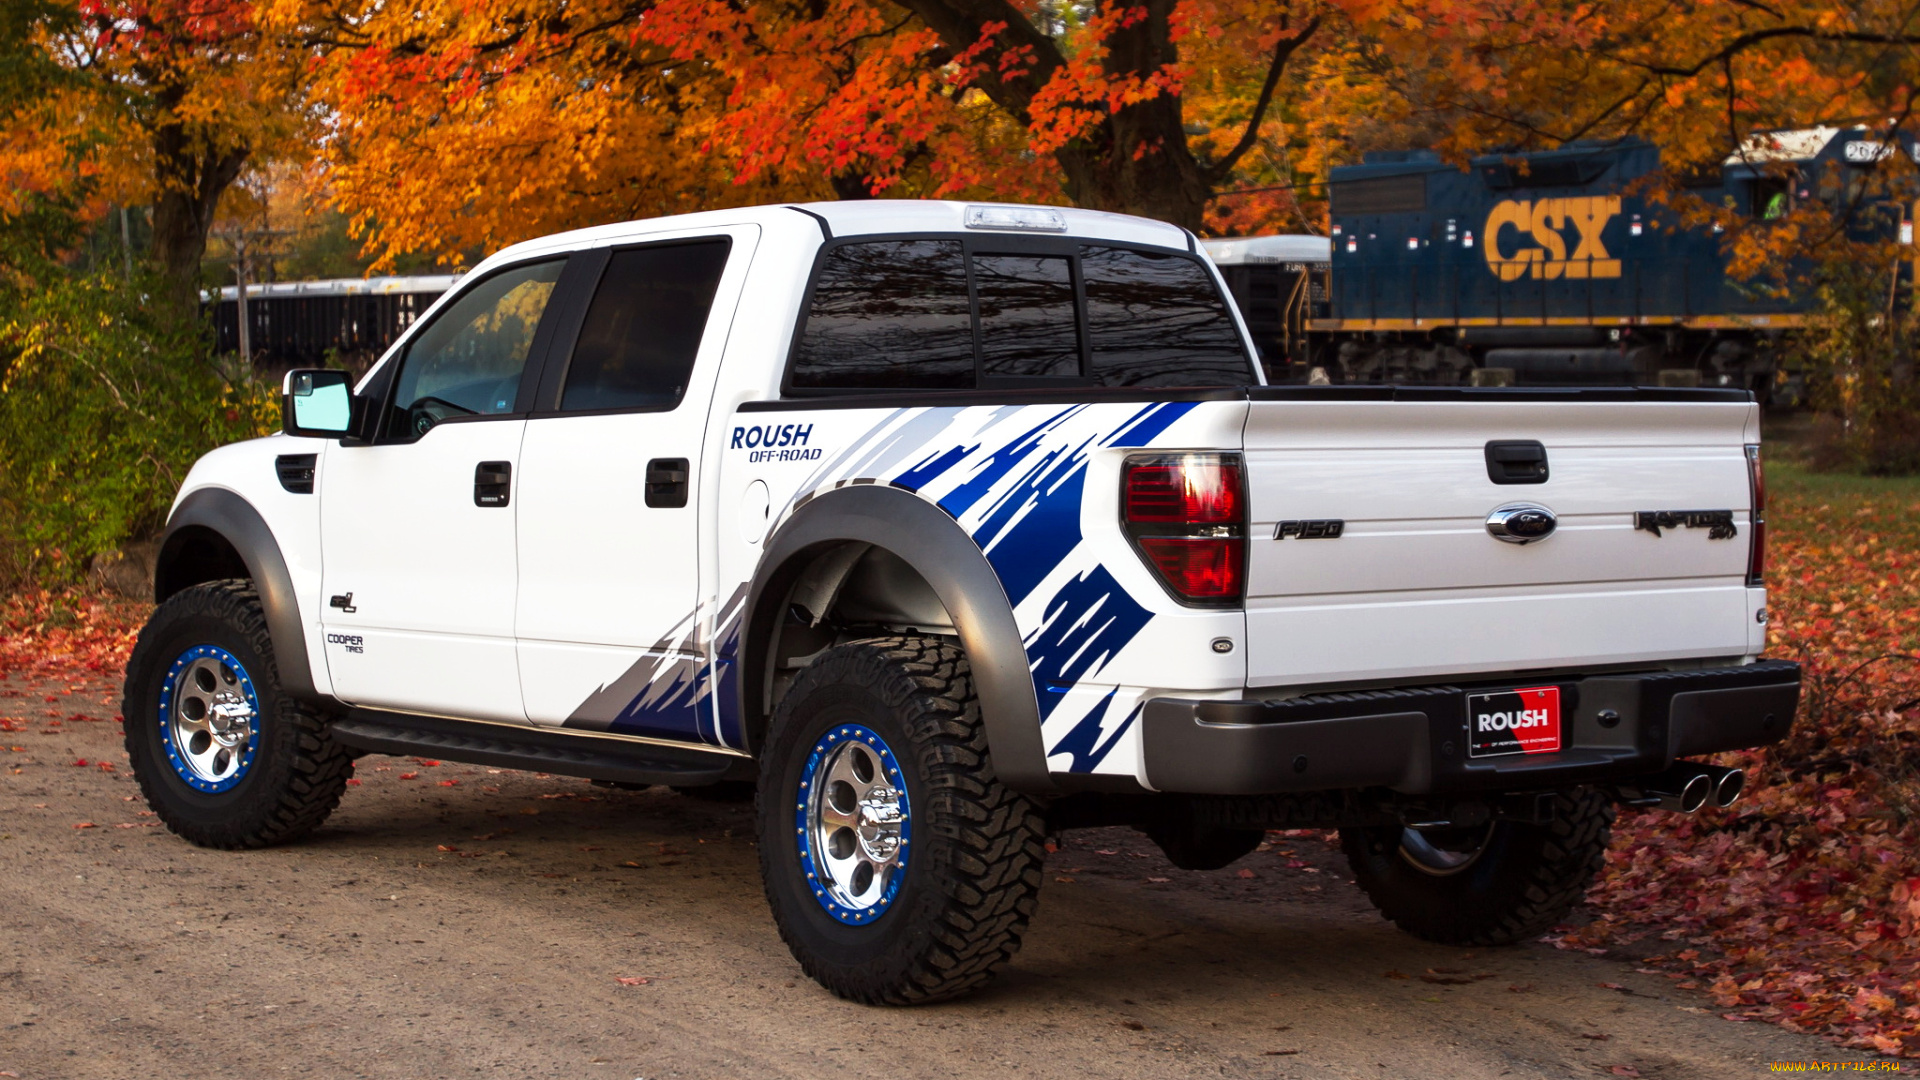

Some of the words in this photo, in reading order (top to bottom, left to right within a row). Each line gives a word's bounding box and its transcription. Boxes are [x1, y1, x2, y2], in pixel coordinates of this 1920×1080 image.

[1484, 195, 1622, 283] CSX
[730, 423, 814, 449] ROUSH
[327, 633, 364, 646] COOPER
[345, 645, 364, 654] TIRES
[1478, 708, 1548, 732] ROUSH
